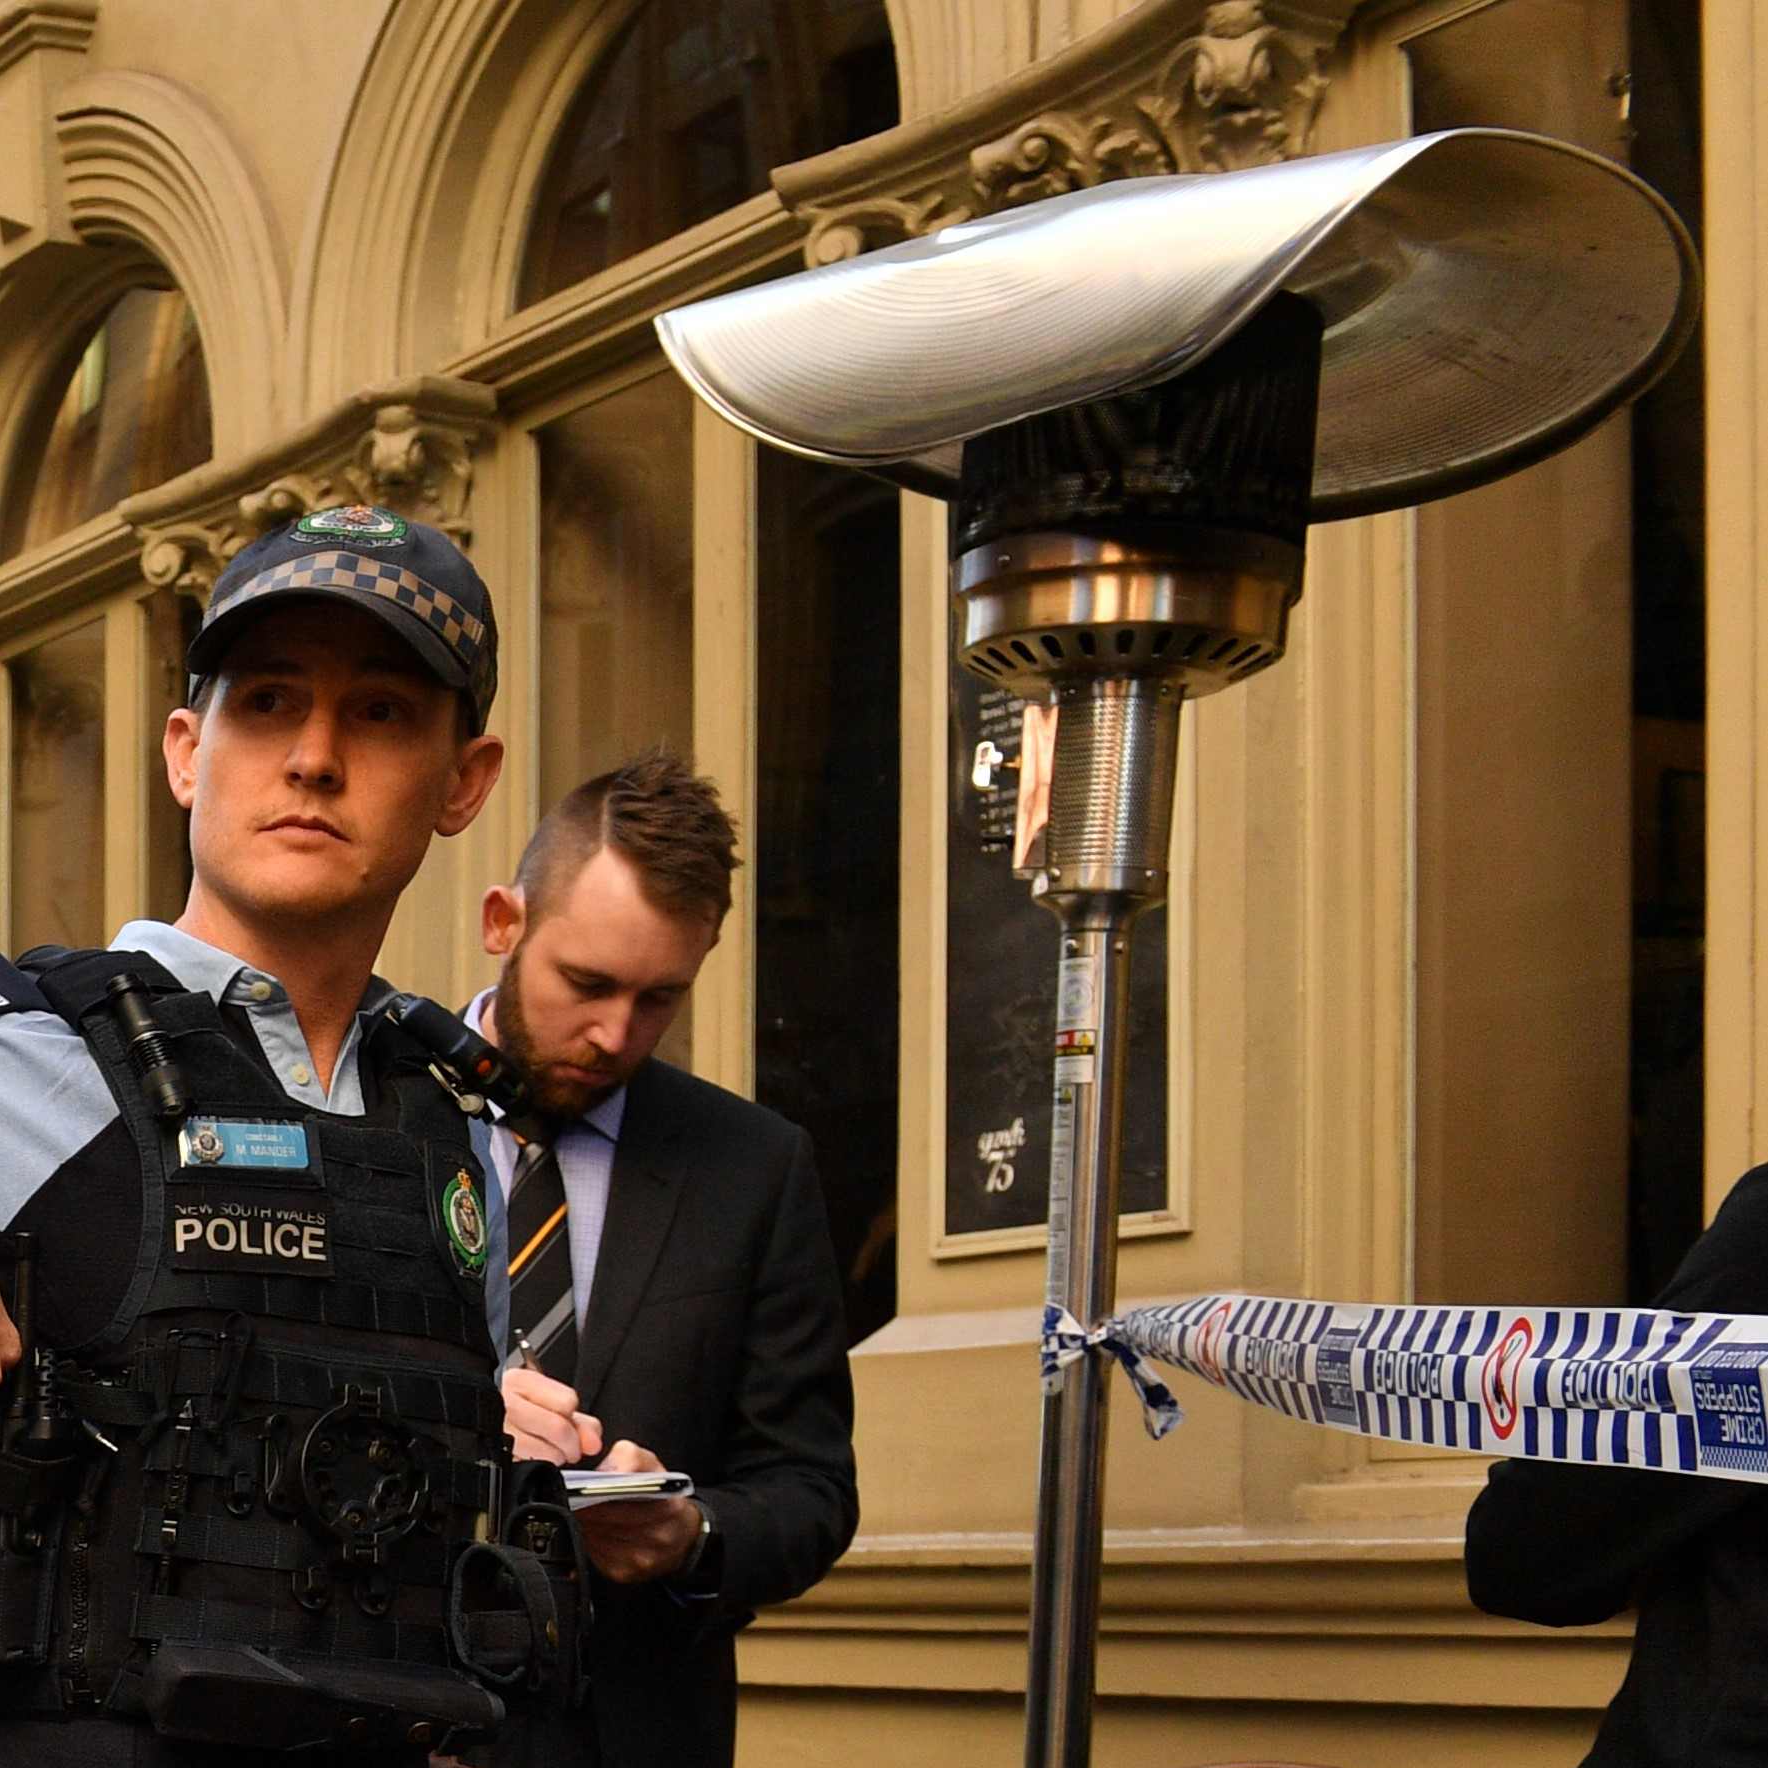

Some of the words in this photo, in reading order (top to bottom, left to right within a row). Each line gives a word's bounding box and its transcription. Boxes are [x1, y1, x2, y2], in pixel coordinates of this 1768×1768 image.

[175, 1204, 212, 1216] NEW
[219, 1203, 272, 1218] SOUTH
[276, 1208, 326, 1225] WALES
[174, 1218, 327, 1261] POLICE
[1376, 1353, 1443, 1396] POLICE
[1564, 1362, 1653, 1406] POLICE
[1694, 1383, 1761, 1414] STOPPERS
[1720, 1414, 1764, 1446] CRIME
